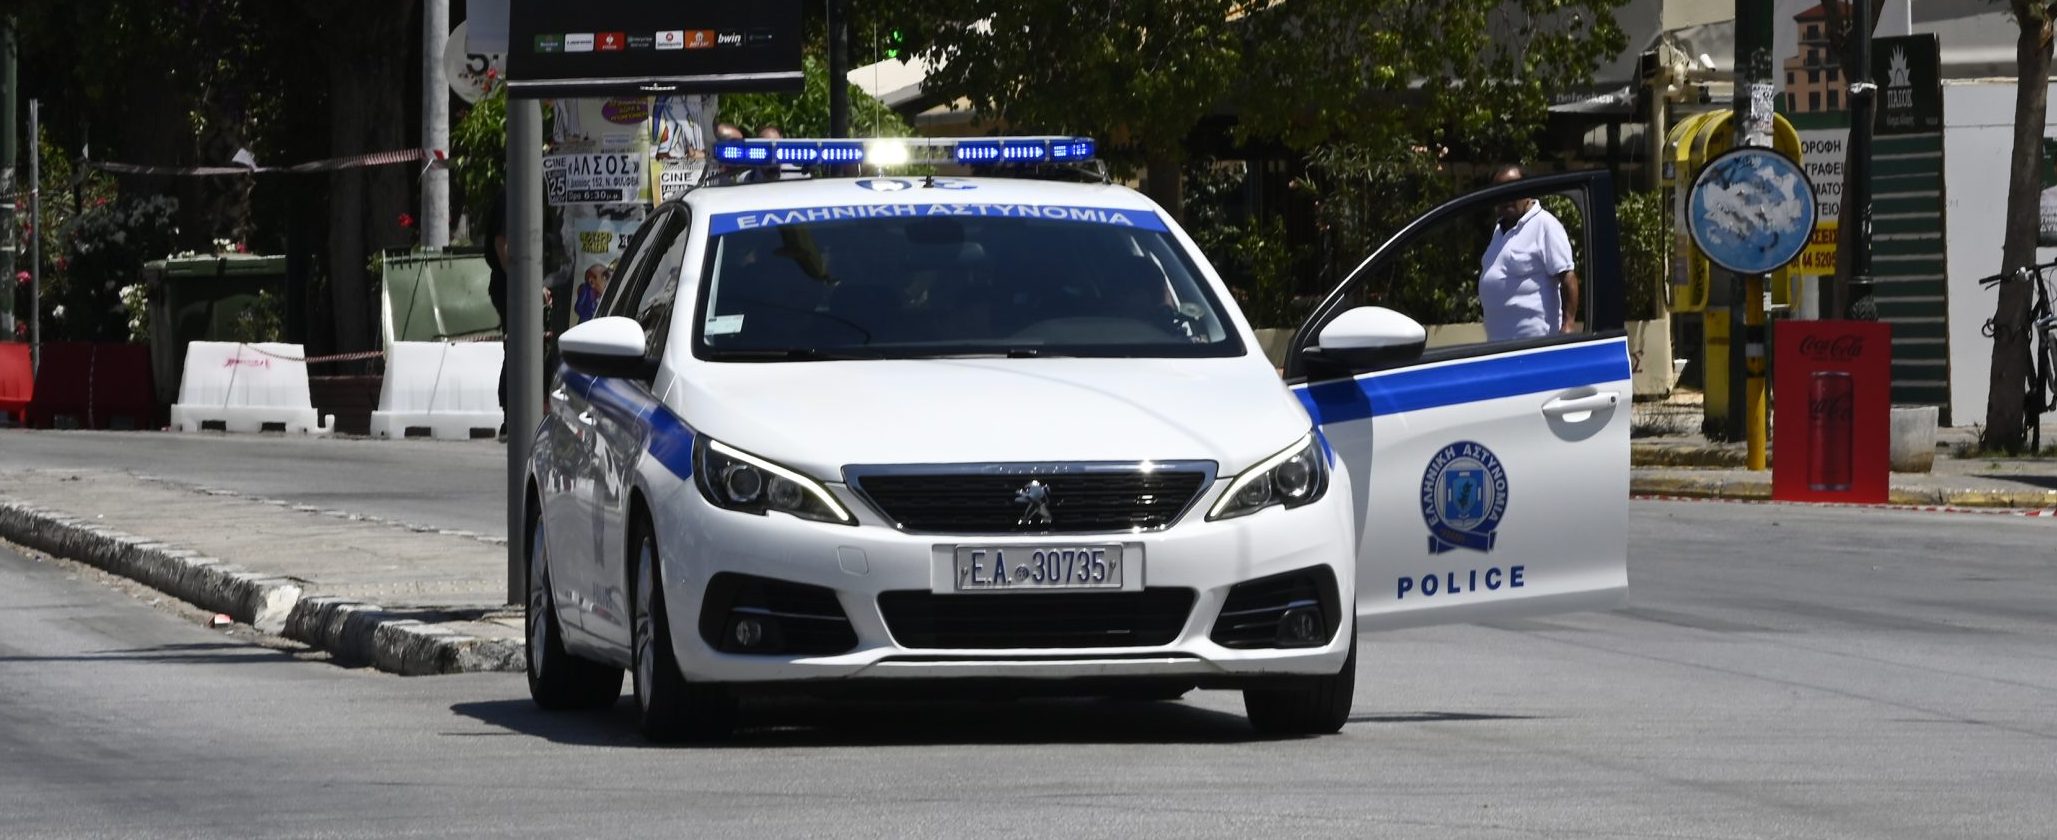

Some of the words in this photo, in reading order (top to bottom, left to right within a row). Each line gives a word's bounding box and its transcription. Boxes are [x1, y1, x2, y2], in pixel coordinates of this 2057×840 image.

[717, 32, 741, 43] bwin
[543, 157, 566, 168] CINE
[1804, 162, 1844, 176] ΓΡΑΦΕΙ
[550, 177, 566, 196] 25
[661, 172, 692, 183] CINE
[737, 203, 917, 230] ΕΛΛΗΝΙΚΗ
[926, 203, 1134, 226] ΑΣΤΥΝΟΜΙΑ
[1423, 445, 1456, 526] ΕΛΛΗΝΙΚΗ
[1463, 443, 1506, 522] ΑΣΤΥΝΟΜΙΑ
[1032, 548, 1106, 584] 30735
[1397, 565, 1525, 600] POLICE
